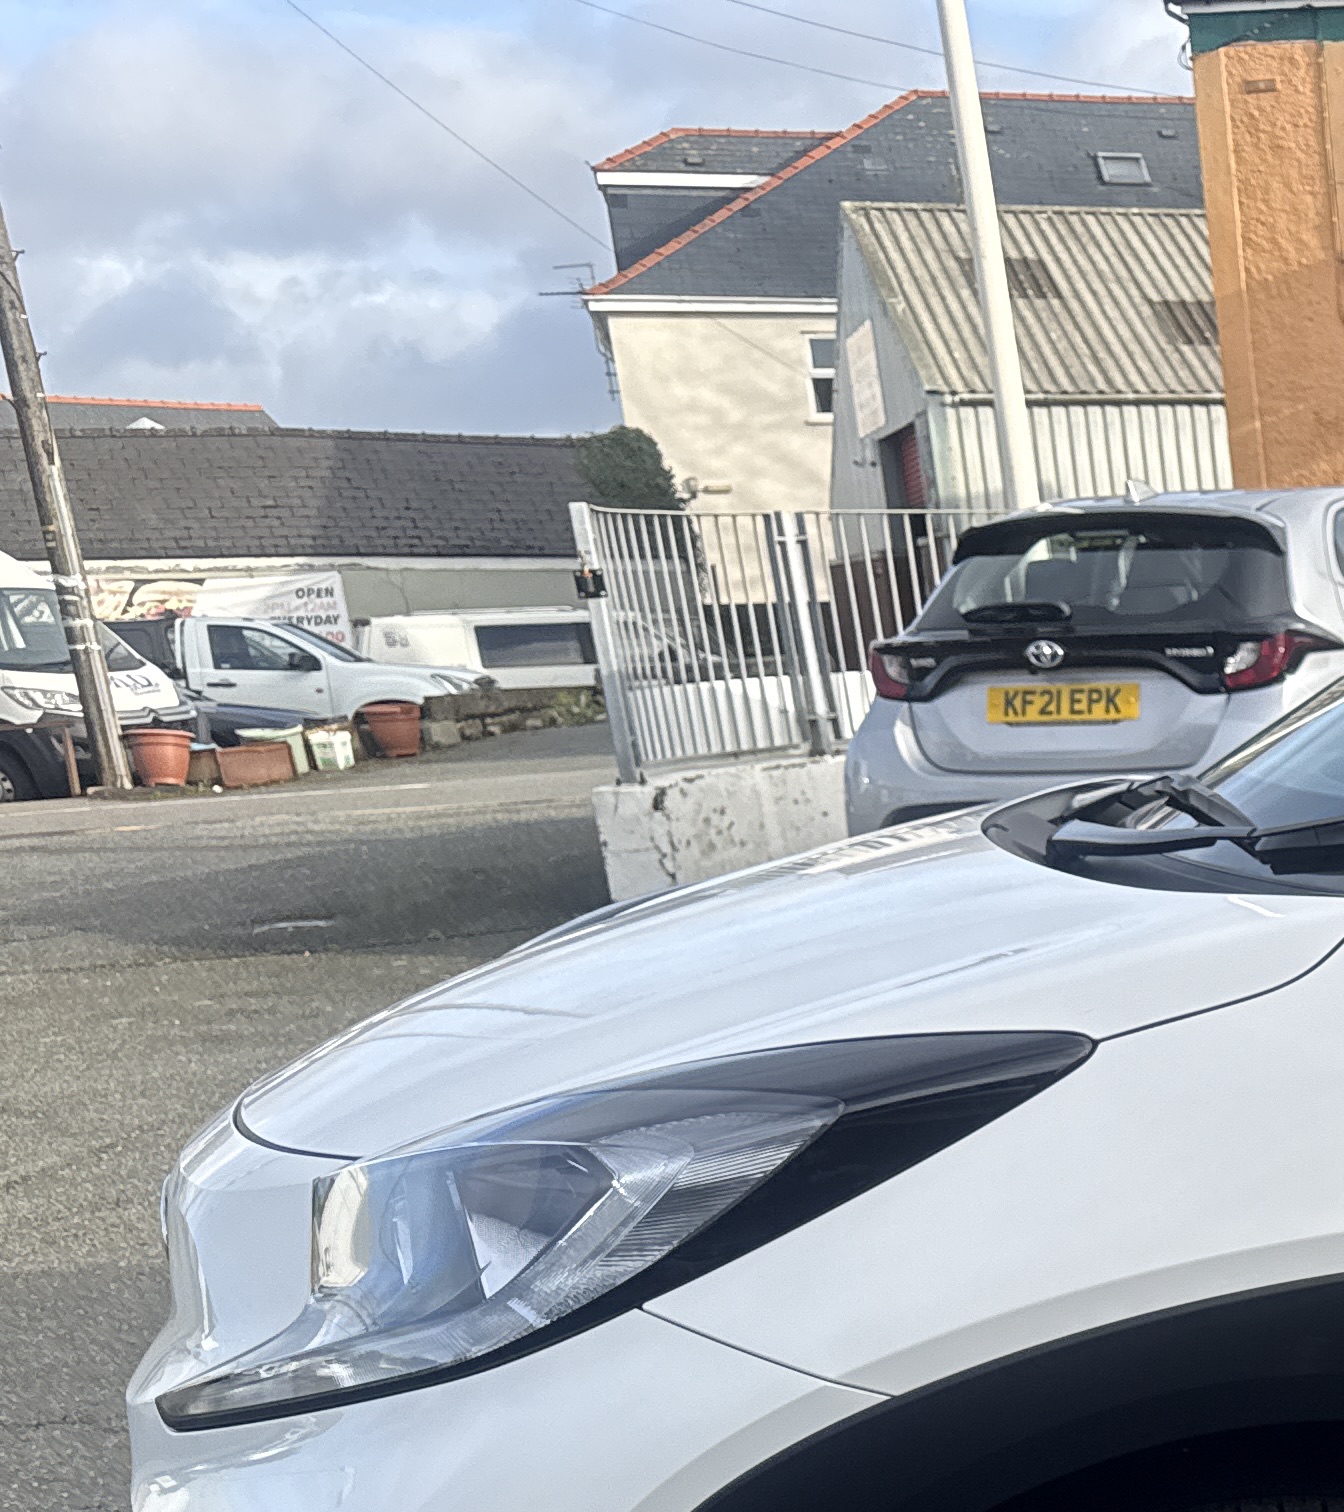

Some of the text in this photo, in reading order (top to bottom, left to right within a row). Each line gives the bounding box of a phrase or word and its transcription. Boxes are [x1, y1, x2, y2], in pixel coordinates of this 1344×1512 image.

[295, 585, 334, 600] OPEN
[1003, 687, 1122, 717] KF21 EPK
